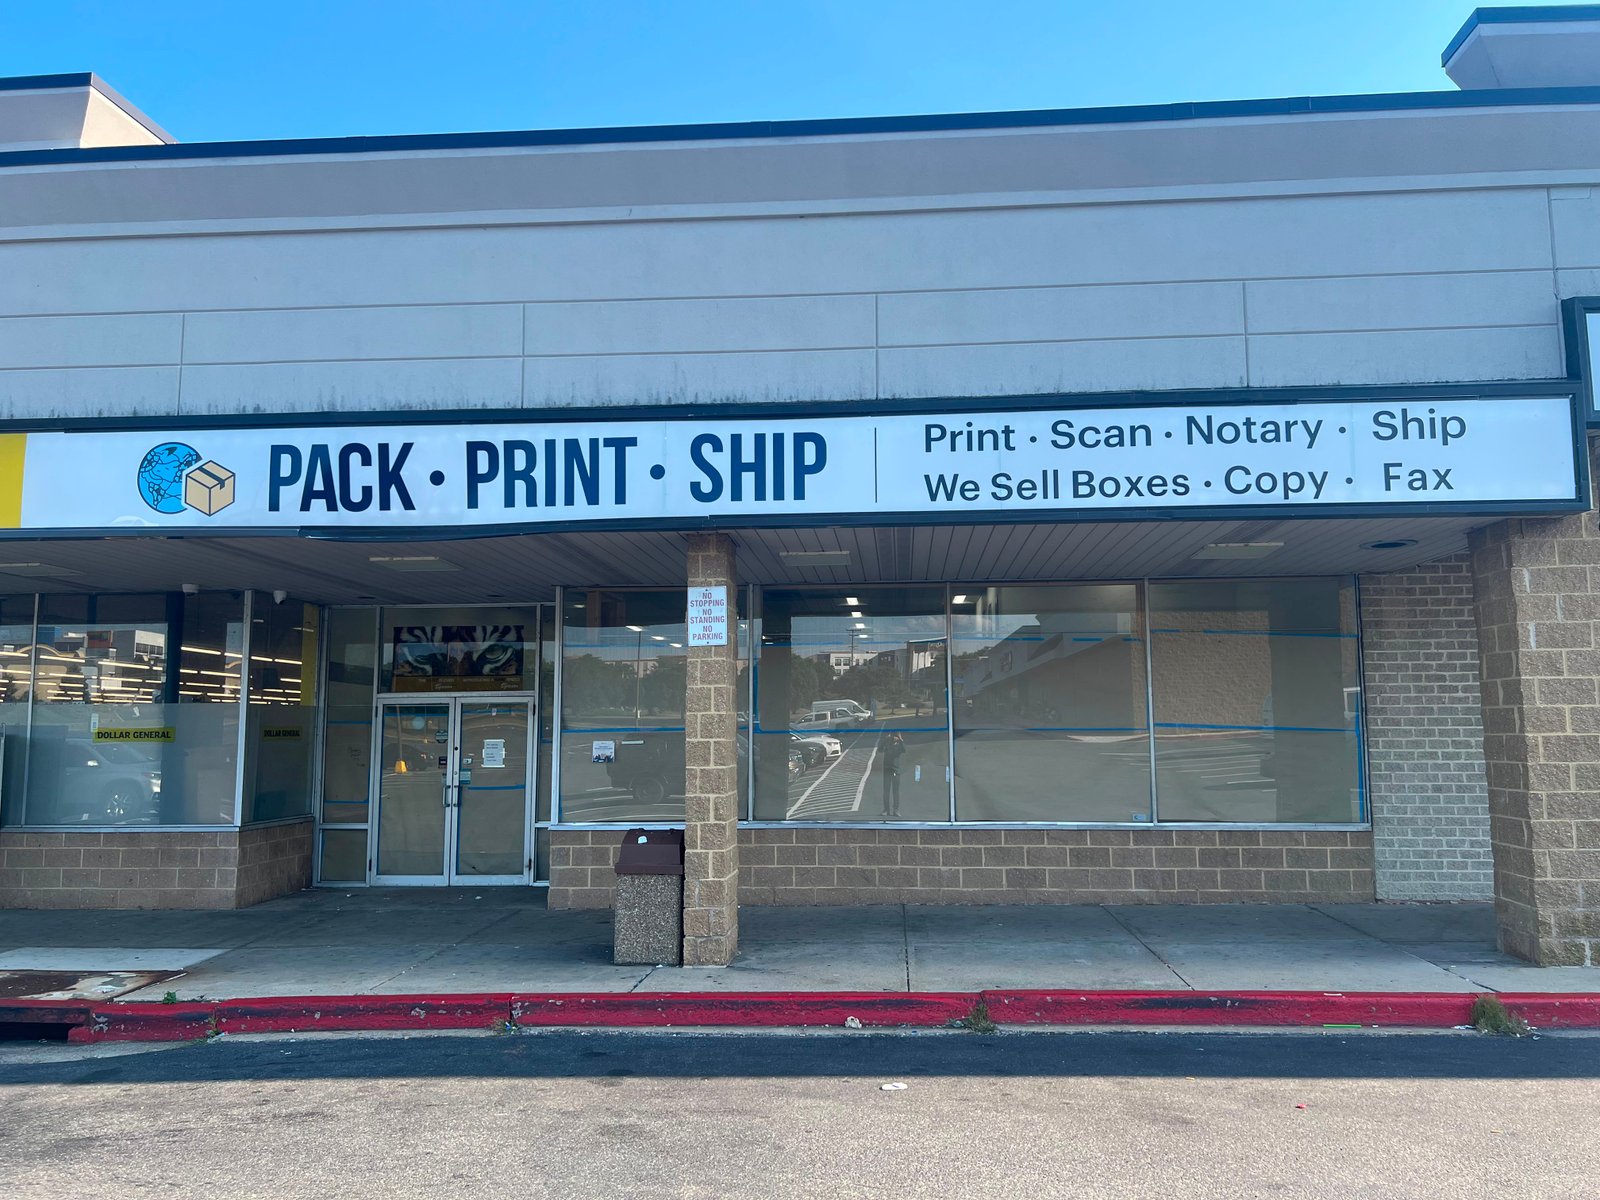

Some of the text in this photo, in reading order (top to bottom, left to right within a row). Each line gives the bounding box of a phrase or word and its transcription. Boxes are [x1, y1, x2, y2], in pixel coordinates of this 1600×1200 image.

[924, 407, 1467, 453] Print Scan Notary Ship
[268, 431, 827, 513] PACK PRINT SHIP
[924, 462, 1454, 502] We Sell Boxes Copy Fax
[690, 599, 725, 607] STOPPING
[690, 616, 725, 624] STANDING
[692, 632, 723, 640] PARKING
[97, 731, 171, 739] DOLLAR GENERAL
